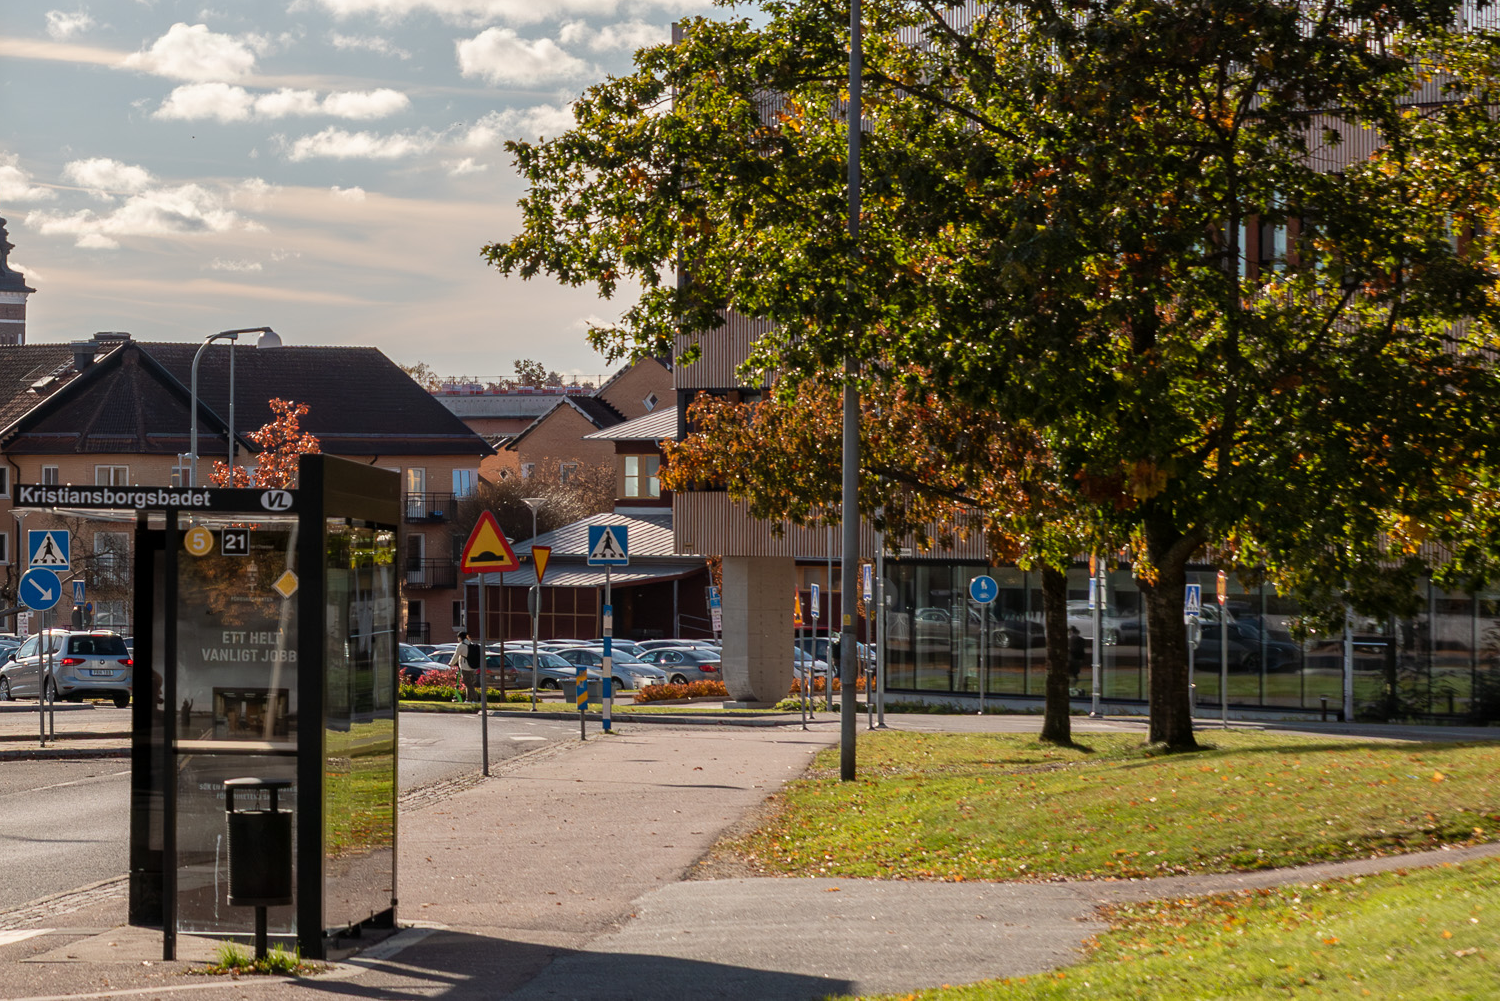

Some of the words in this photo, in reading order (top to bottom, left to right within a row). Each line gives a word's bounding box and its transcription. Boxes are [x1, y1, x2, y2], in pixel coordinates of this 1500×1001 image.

[19, 486, 211, 508] Kristiansborgsbadet
[266, 491, 289, 507] VL
[193, 533, 205, 550] 5
[225, 534, 245, 549] 21
[222, 631, 247, 644] ETT
[250, 632, 282, 645] HELT
[201, 648, 258, 661] VANLIGT
[261, 649, 298, 663] JOBB
